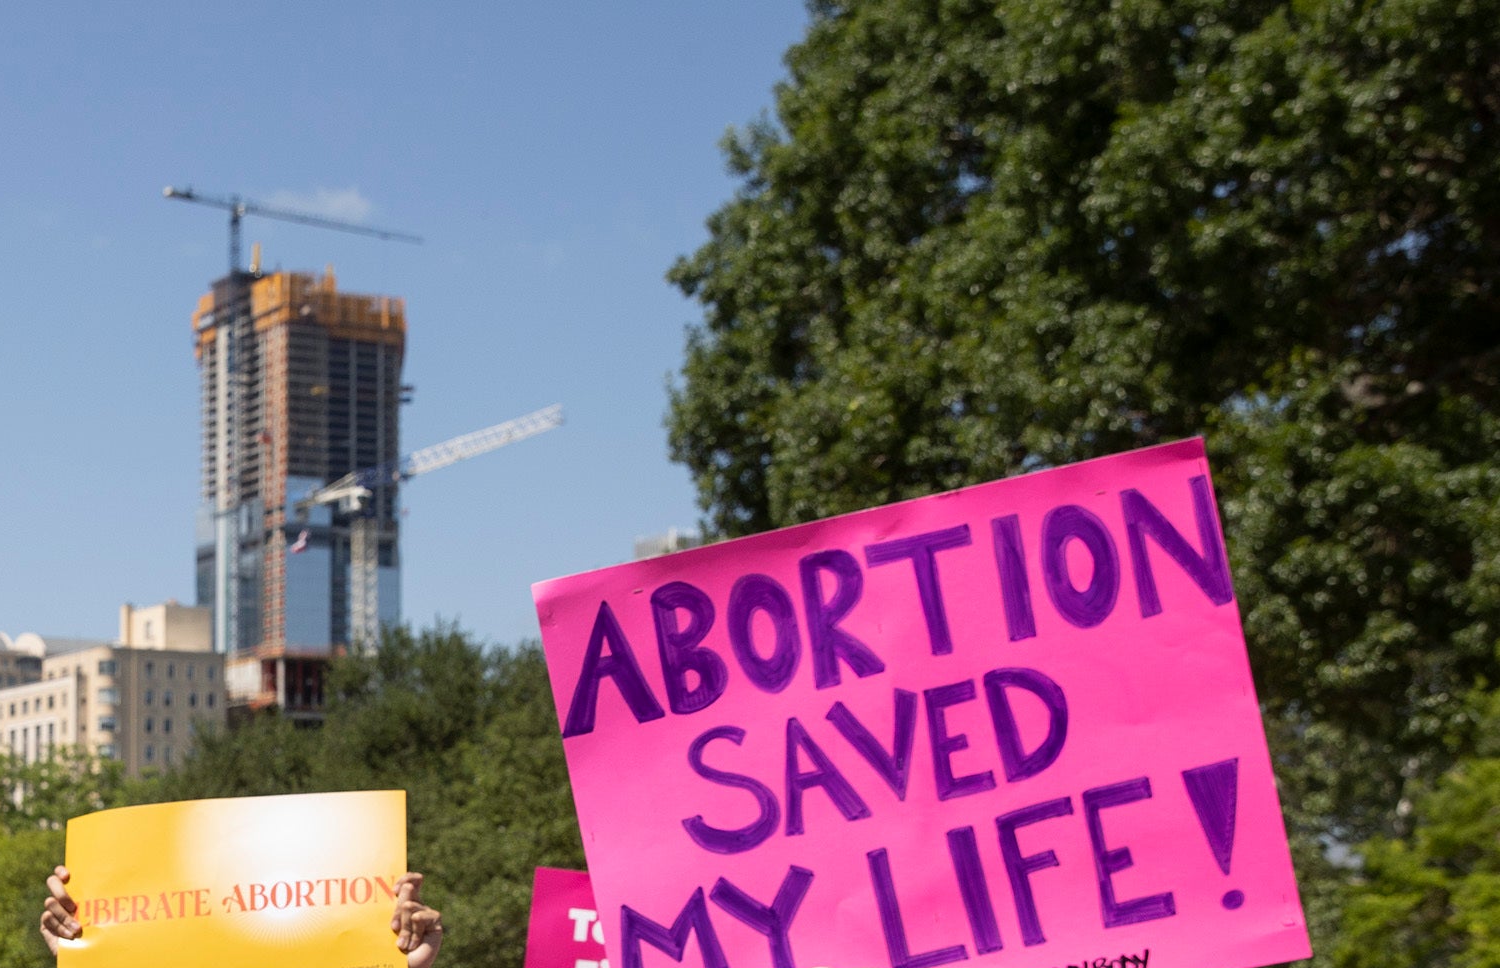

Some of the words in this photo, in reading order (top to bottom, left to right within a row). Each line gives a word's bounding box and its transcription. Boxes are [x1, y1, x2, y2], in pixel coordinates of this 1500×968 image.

[561, 475, 1234, 739] ABORTION
[681, 667, 1069, 854] SAVED
[222, 876, 398, 914] ABORTION
